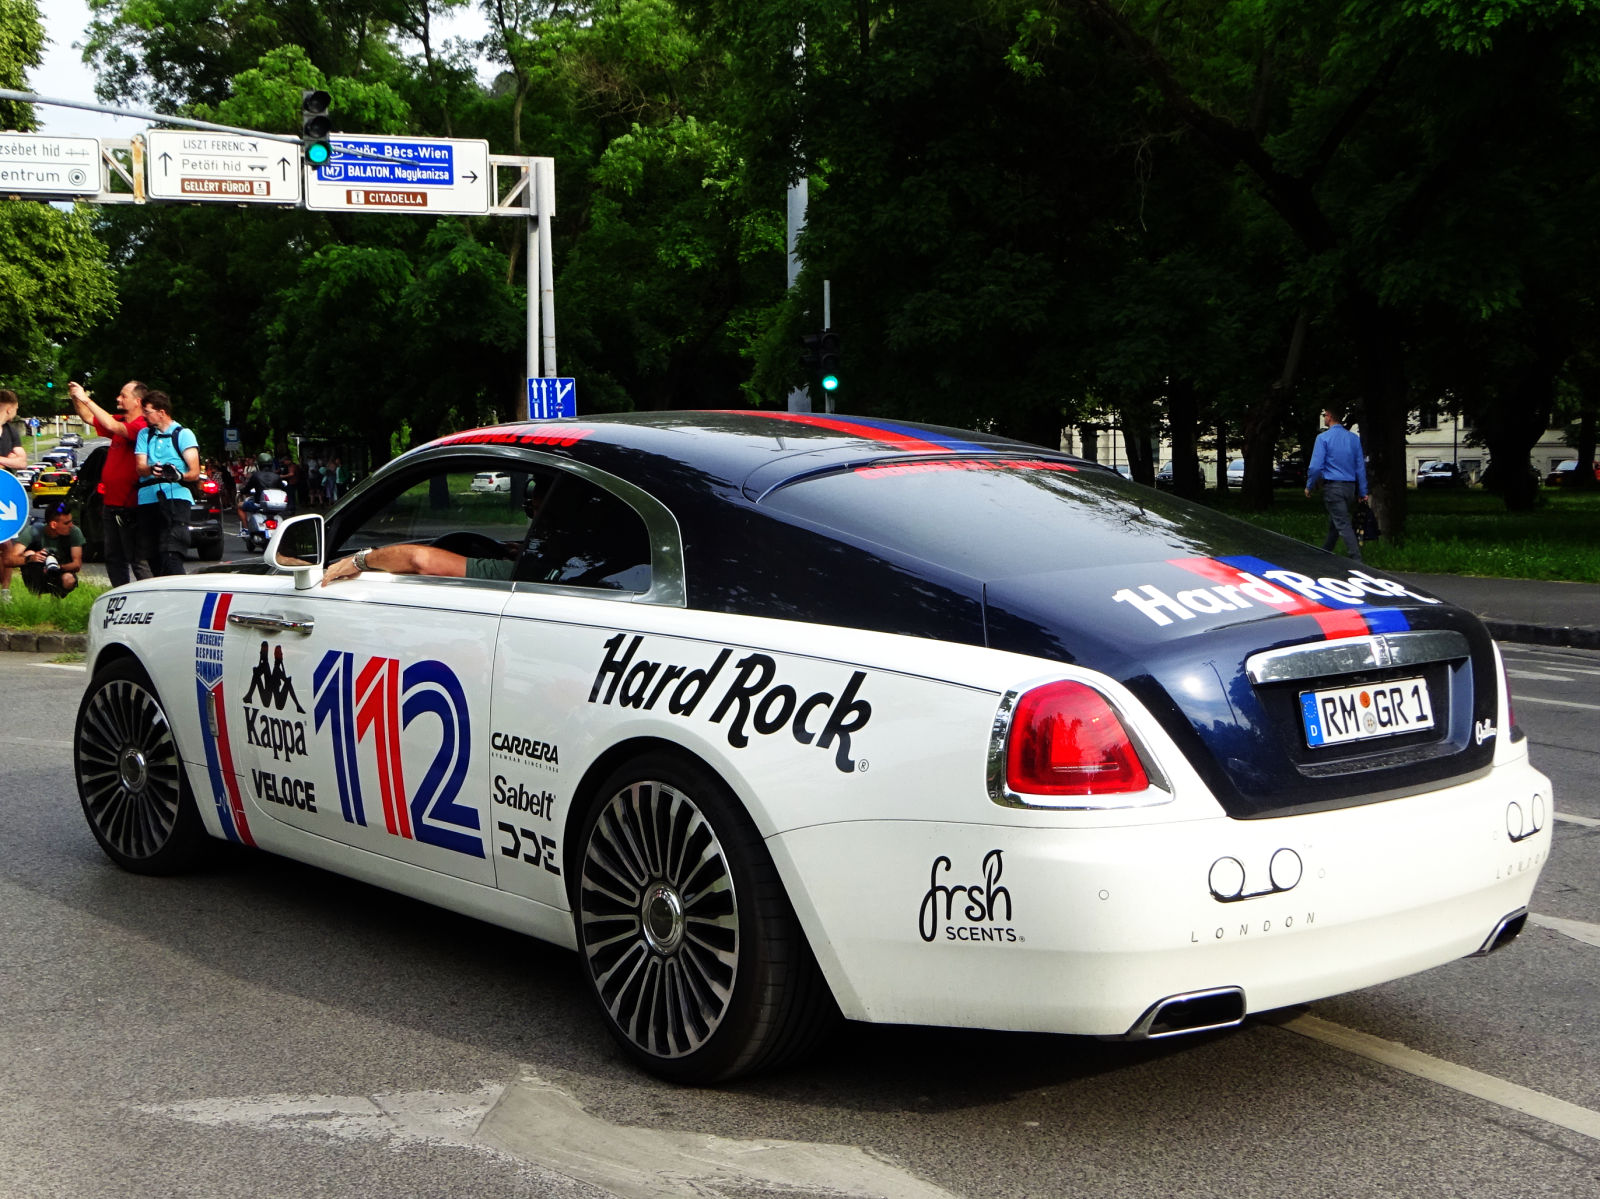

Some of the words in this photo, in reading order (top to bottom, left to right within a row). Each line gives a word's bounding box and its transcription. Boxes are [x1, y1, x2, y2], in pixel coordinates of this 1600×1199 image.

[183, 139, 208, 150] LISZT
[211, 140, 245, 152] FERENC
[0, 168, 60, 182] entrum
[184, 180, 220, 193] GELLÉRT
[325, 165, 340, 177] M7
[348, 165, 394, 180] BALATON,
[395, 166, 449, 182] Nagykanizsa
[368, 193, 423, 204] CITADELLA
[1111, 573, 1295, 627] Hard
[1263, 569, 1443, 605] Rock
[588, 633, 734, 717] Hard
[708, 653, 872, 773] Rock
[1321, 693, 1361, 737] RM
[1373, 687, 1409, 728] GR
[1411, 685, 1429, 722] 1
[244, 706, 309, 763] Kappa
[1310, 724, 1318, 737] D
[313, 649, 486, 860] 112
[491, 732, 559, 765] CARRERA
[252, 768, 318, 814] VELOCE
[493, 774, 554, 822] Sabelt
[918, 848, 1013, 942] frsh
[1191, 911, 1316, 943] LONDON
